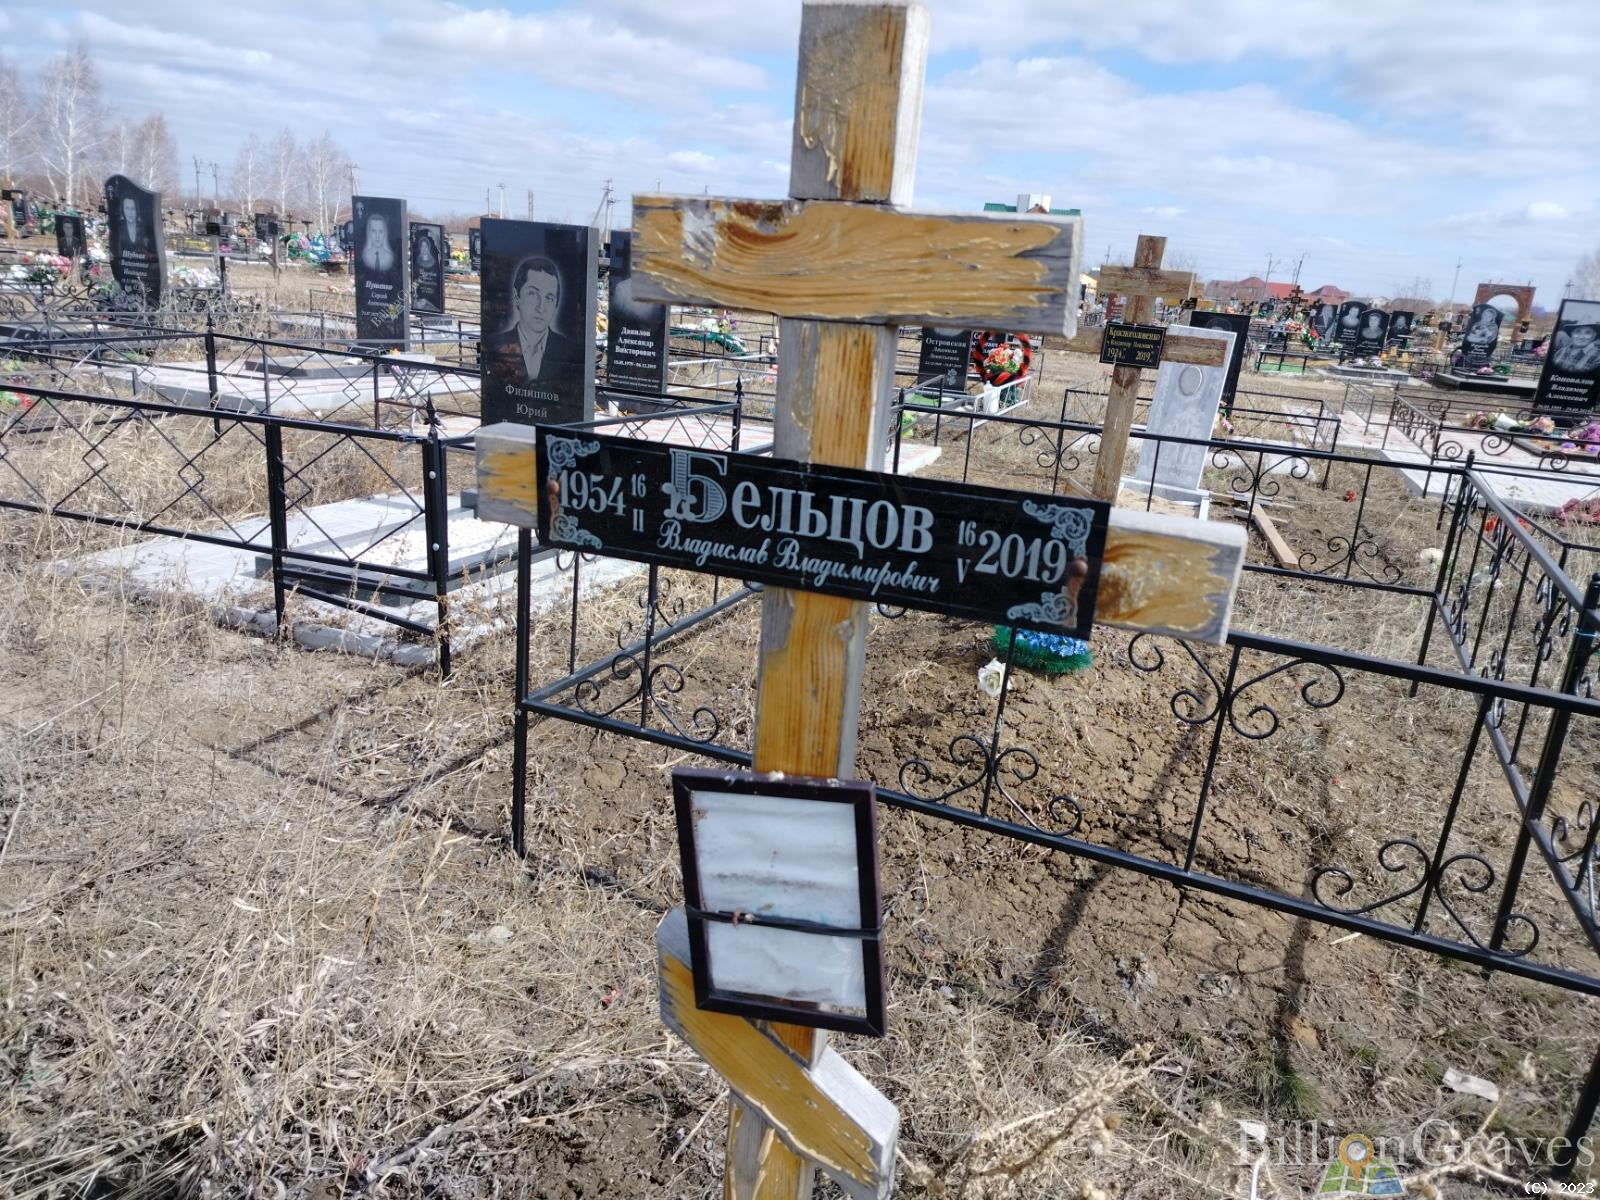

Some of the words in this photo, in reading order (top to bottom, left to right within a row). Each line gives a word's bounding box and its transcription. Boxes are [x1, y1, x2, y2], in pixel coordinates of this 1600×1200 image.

[620, 326, 651, 337] Данилов
[618, 337, 654, 348] Александр
[925, 337, 967, 348] Островская
[615, 345, 656, 357] Викторович
[1550, 374, 1594, 385] Коновалов
[505, 384, 560, 402] Филиппов
[1551, 384, 1588, 394] Владимир
[516, 403, 547, 418] Юрий
[559, 469, 626, 517] 1954
[631, 473, 647, 498] 16
[661, 448, 934, 560] Бельцов
[958, 520, 977, 546] 16
[657, 519, 771, 567] Владислав
[772, 537, 941, 596] Владимирович
[974, 529, 1067, 584] 2019
